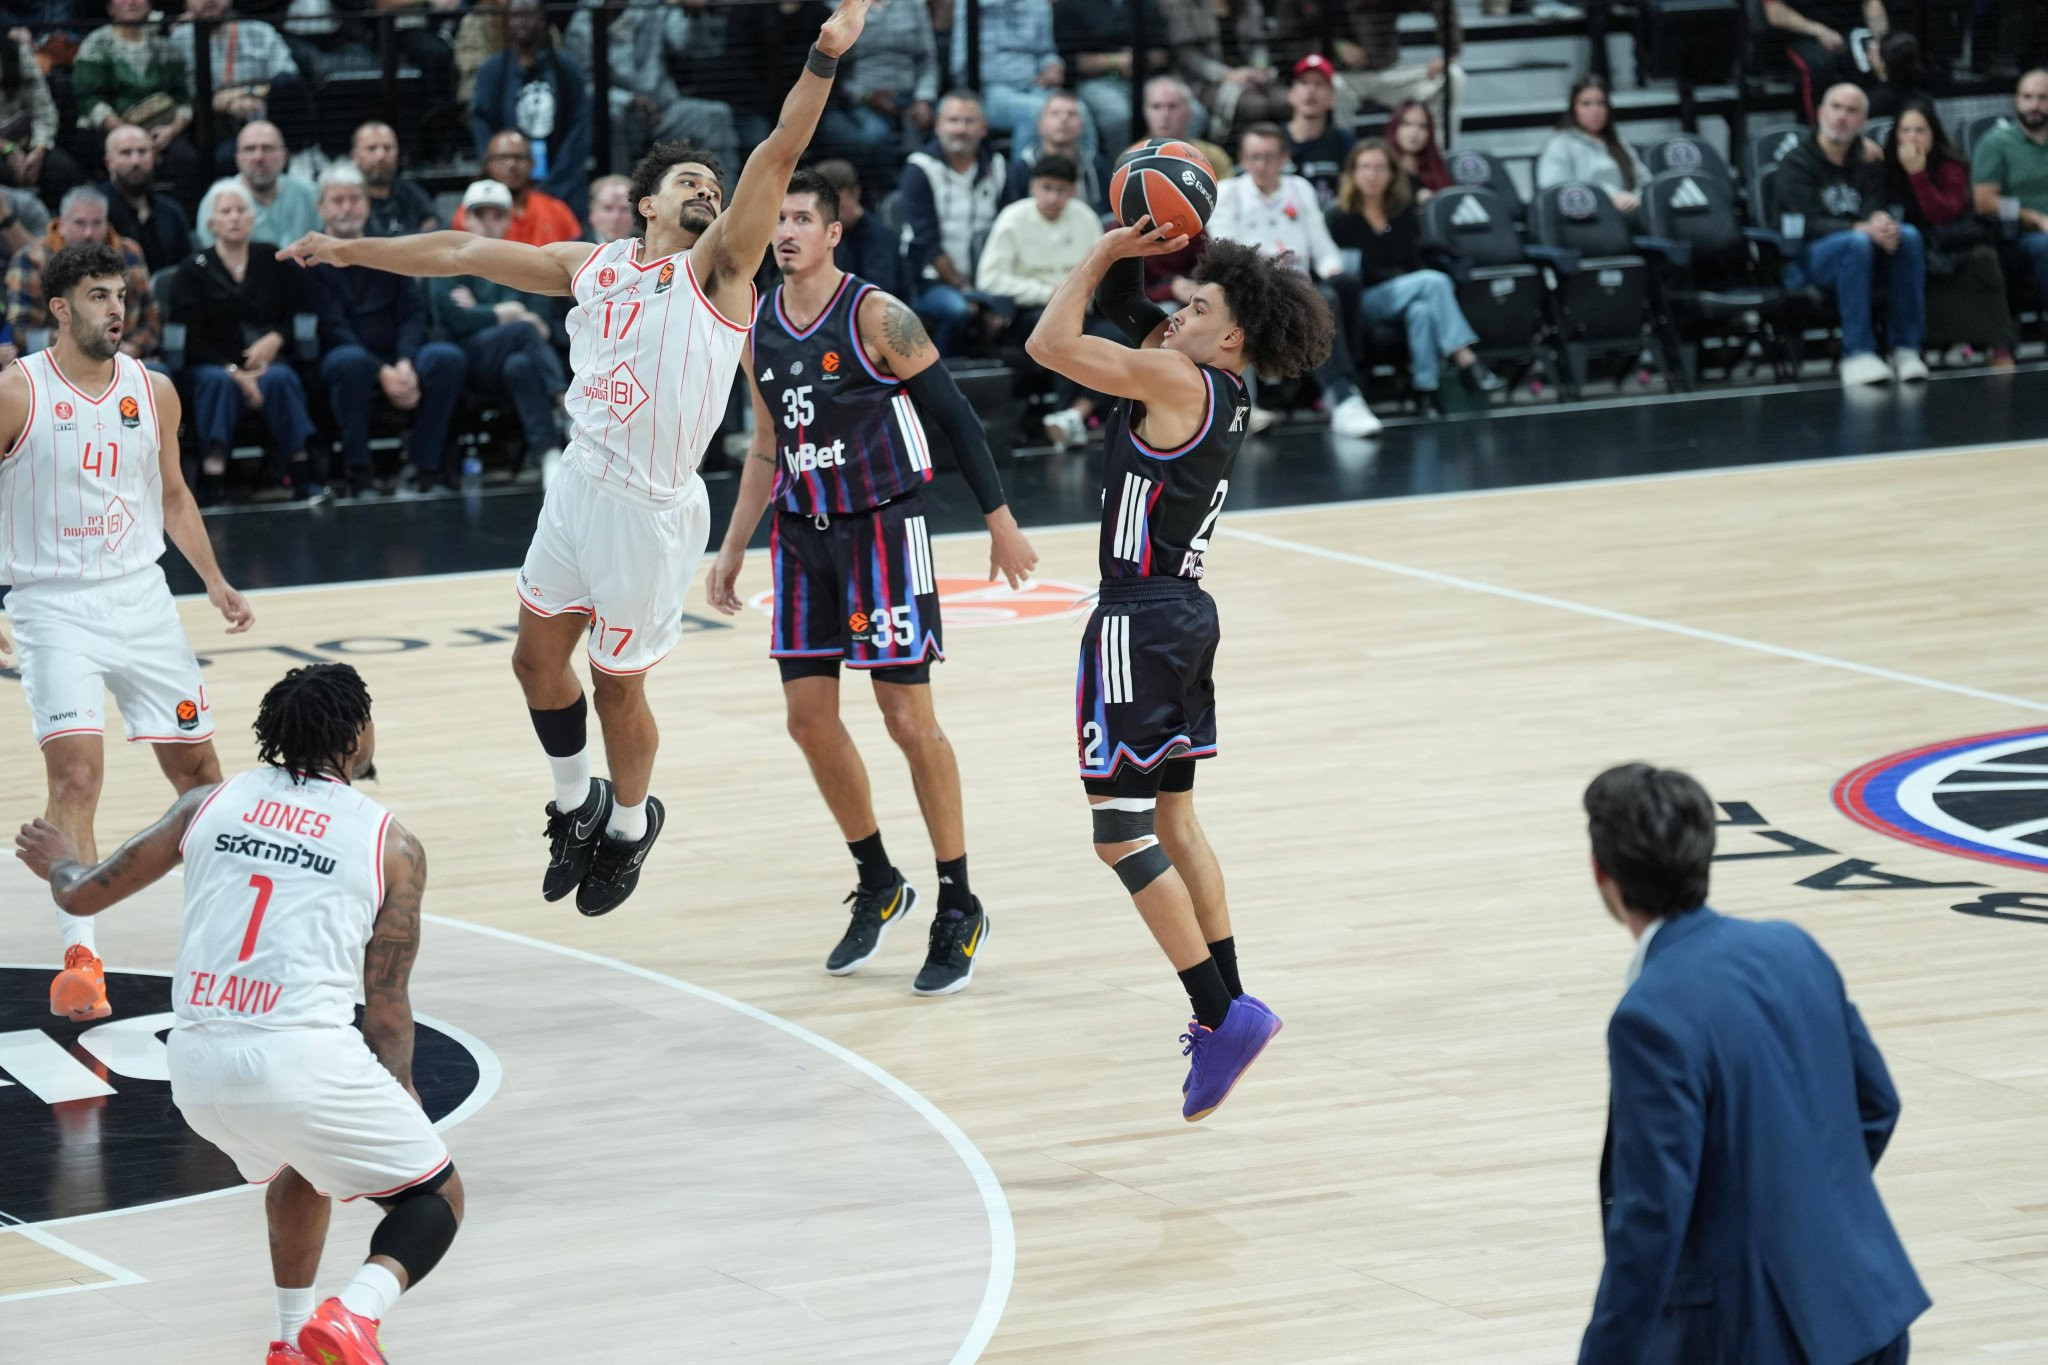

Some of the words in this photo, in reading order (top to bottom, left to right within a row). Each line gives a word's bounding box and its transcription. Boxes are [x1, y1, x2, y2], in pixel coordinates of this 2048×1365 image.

[603, 301, 640, 339] 17
[611, 381, 633, 406] IBI
[782, 385, 815, 429] 35
[83, 442, 118, 477] 41
[63, 526, 104, 538] השקעות
[107, 513, 123, 535] IBI
[1190, 479, 1229, 552] 2
[599, 616, 633, 657] 17
[870, 605, 915, 648] 35
[50, 709, 77, 723] nuvei
[1083, 721, 1104, 766] 2
[243, 799, 331, 839] JONES
[238, 873, 273, 961] 1
[217, 975, 283, 1014] AVIV
